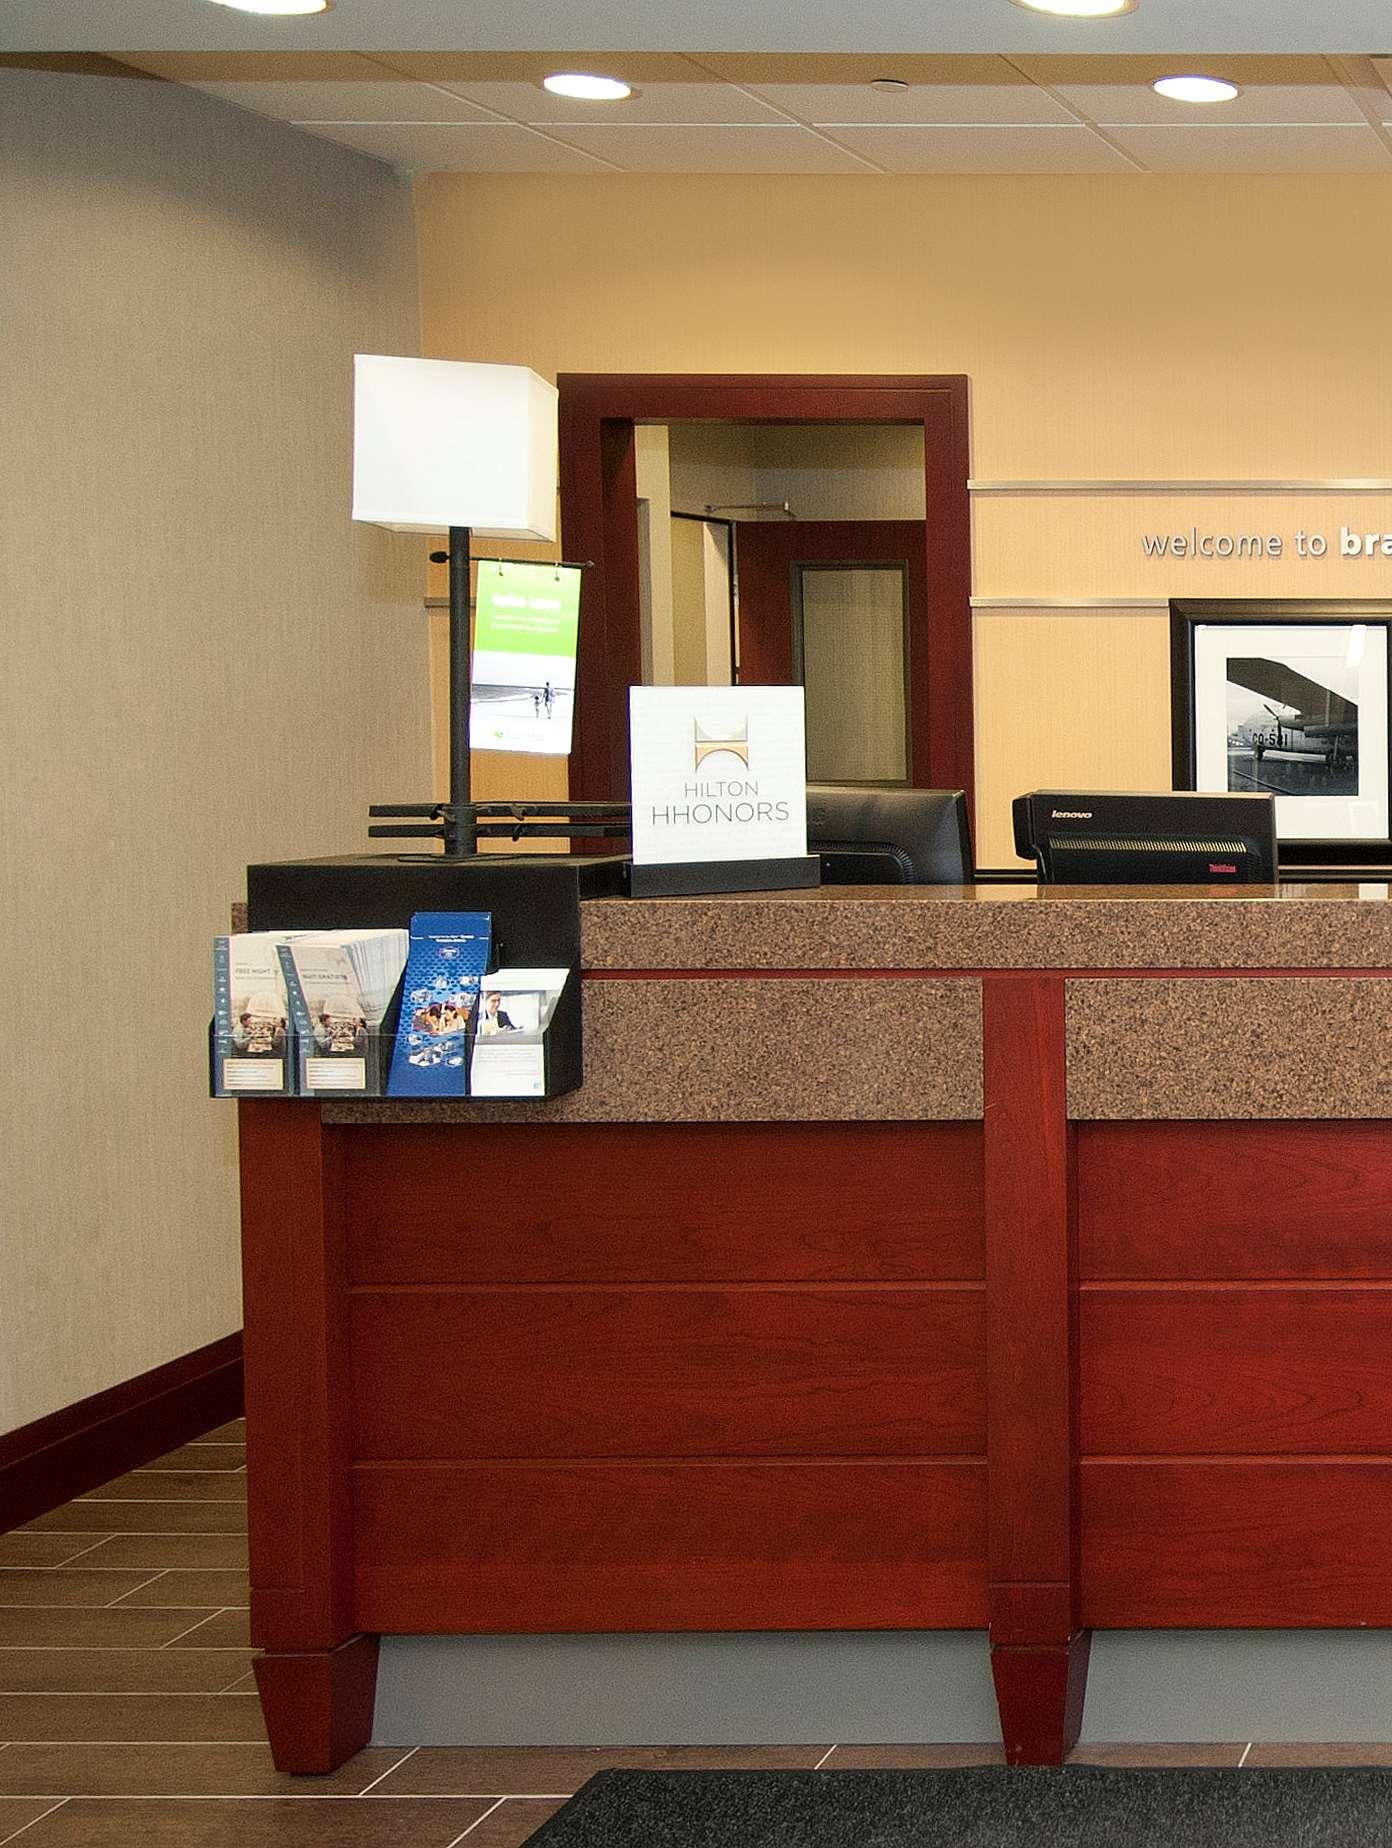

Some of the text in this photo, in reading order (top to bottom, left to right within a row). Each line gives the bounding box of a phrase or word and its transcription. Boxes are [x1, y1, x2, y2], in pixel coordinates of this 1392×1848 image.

[1143, 527, 1283, 557] welcome
[1294, 531, 1328, 557] to
[684, 780, 759, 798] HILTON
[652, 801, 790, 826] HHONORS
[1051, 809, 1093, 819] lenovo
